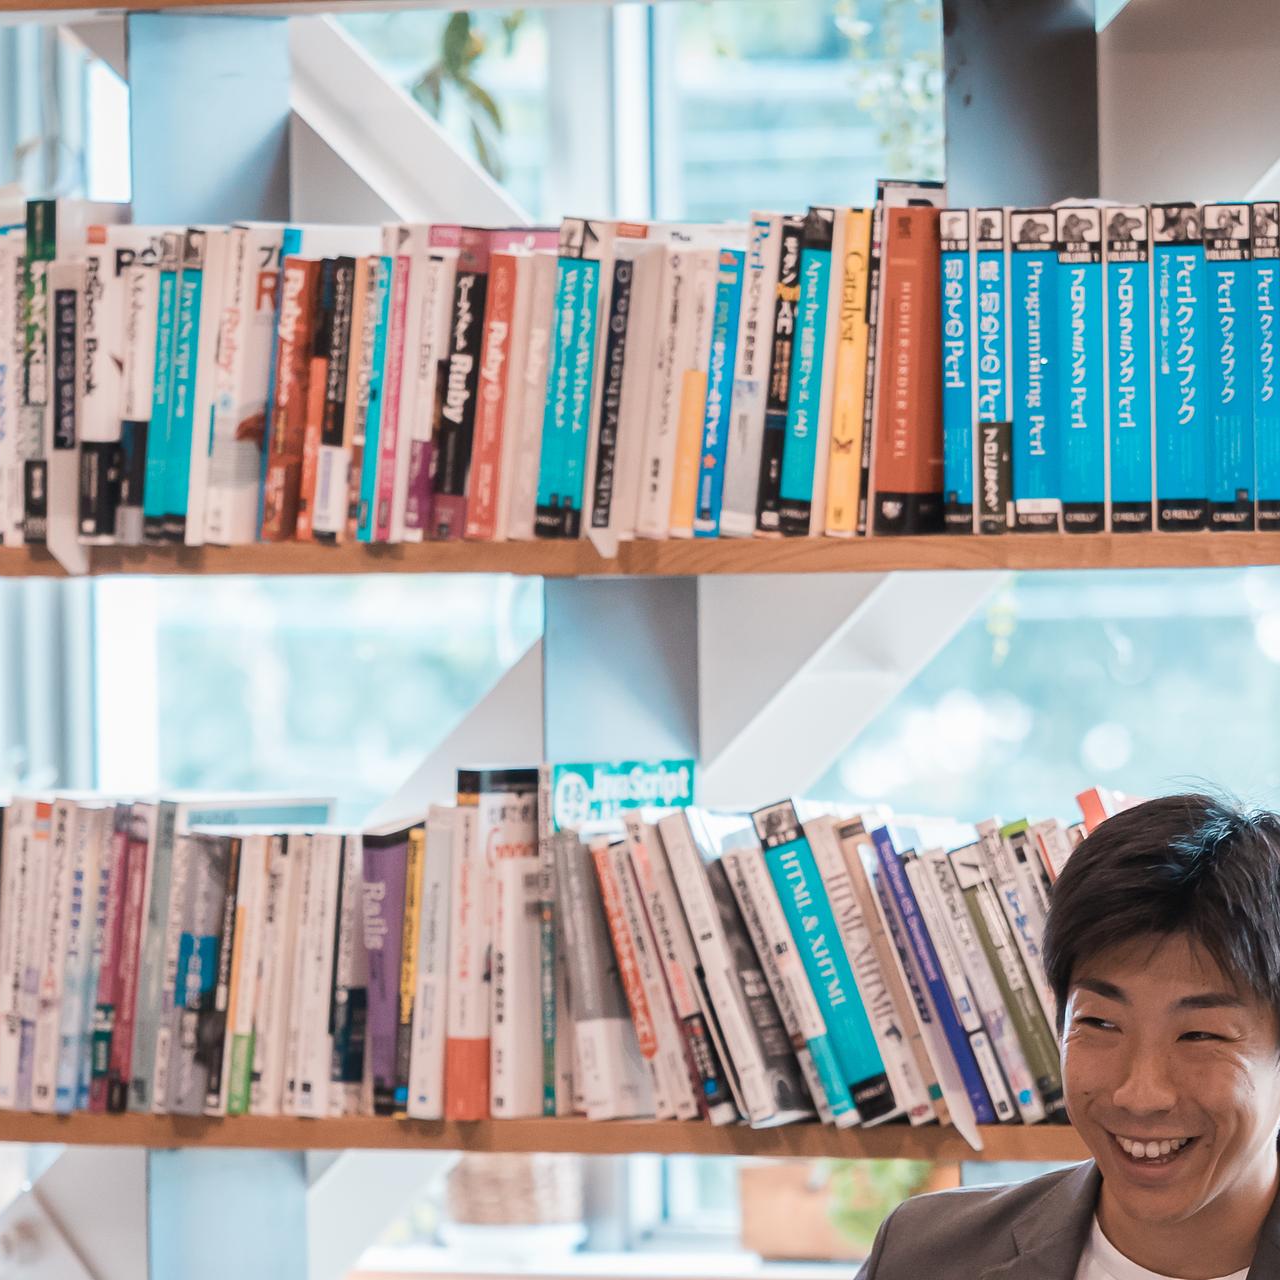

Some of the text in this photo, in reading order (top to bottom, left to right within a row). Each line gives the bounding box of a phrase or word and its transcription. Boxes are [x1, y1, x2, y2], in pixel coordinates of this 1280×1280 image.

[277, 268, 305, 342] Ruby
[840, 251, 865, 343] Catalyst
[481, 320, 509, 383] Ruby
[1023, 260, 1046, 456] Programming Perl
[442, 353, 473, 424] Ruby
[893, 418, 907, 460] PERL
[1161, 508, 1202, 521] O'REILLY
[1213, 511, 1250, 523] O'REILLY
[593, 763, 690, 807] JavaScript
[362, 881, 389, 950] Rails
[779, 850, 848, 1008] HTML & XHTML
